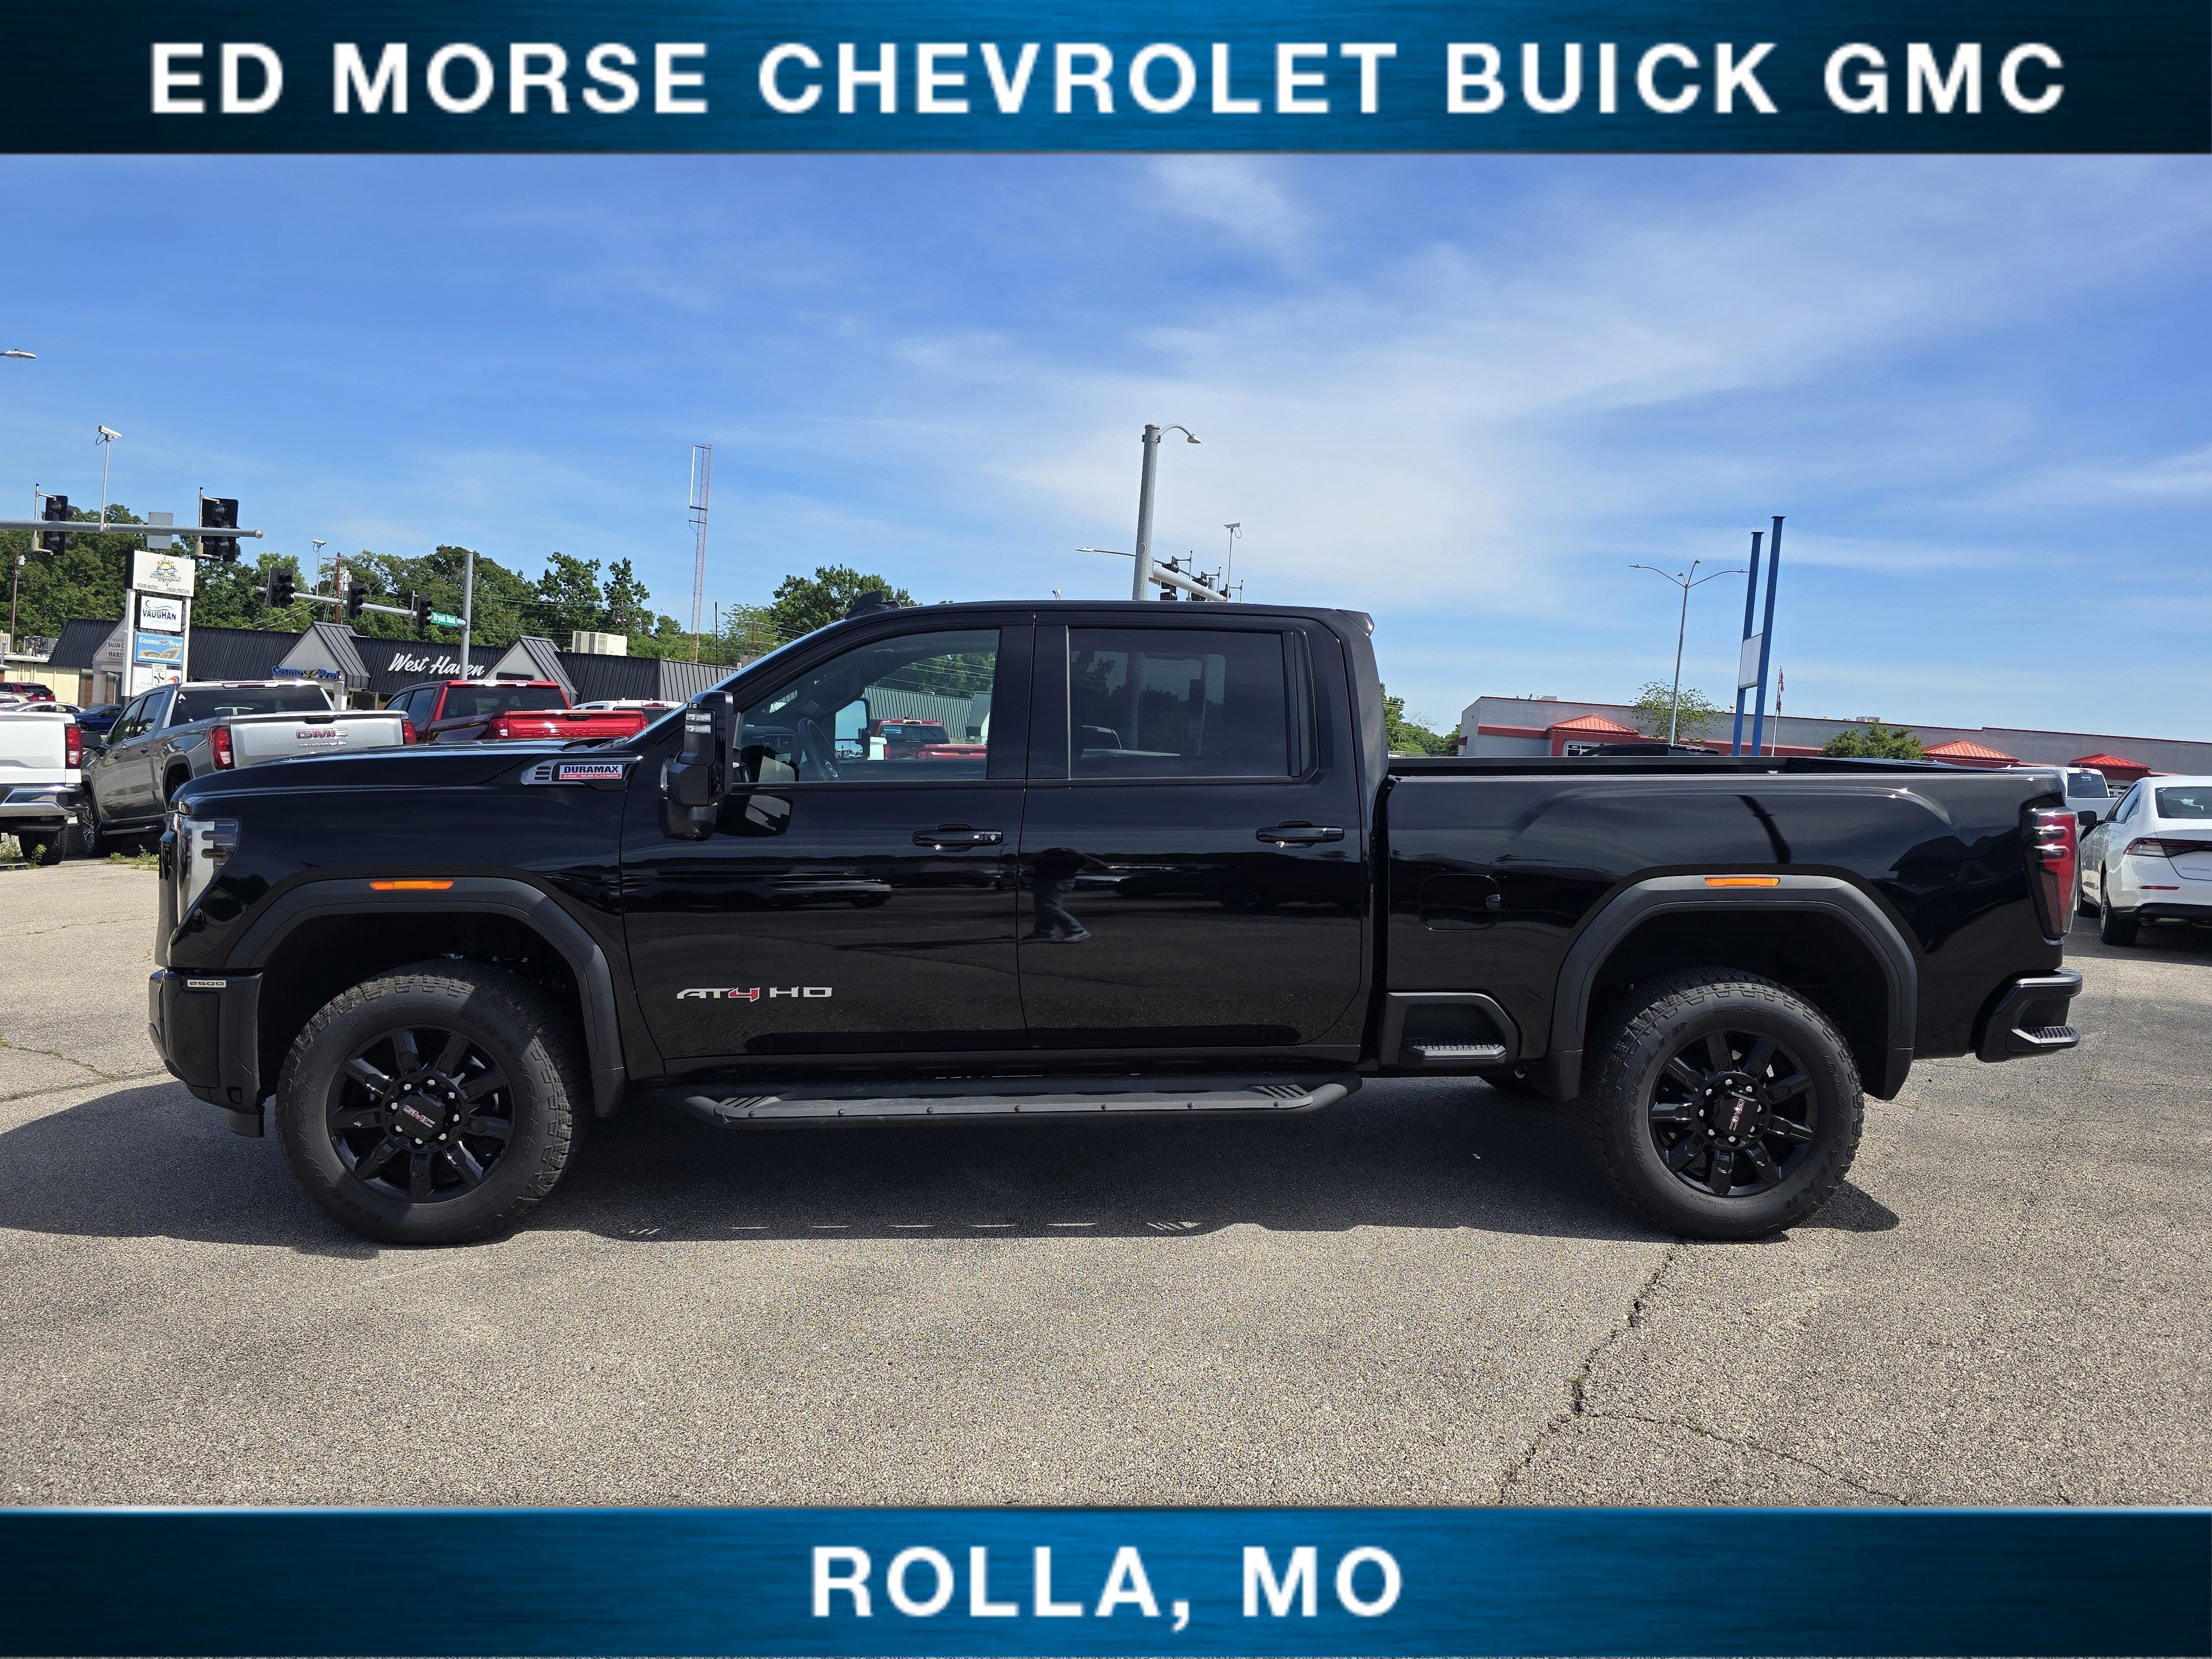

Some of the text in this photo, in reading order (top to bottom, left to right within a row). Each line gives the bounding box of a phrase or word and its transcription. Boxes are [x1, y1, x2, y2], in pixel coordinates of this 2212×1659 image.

[143, 608, 176, 620] VAUGHAN
[139, 637, 160, 645] Cosmo
[388, 653, 430, 672] West
[272, 665, 342, 680] Cosmo Prof
[296, 728, 348, 739] GMC
[677, 986, 833, 1003] AT4 HD
[1626, 1020, 1688, 1165] WRANGLER
[403, 1104, 436, 1128] GMC
[1729, 1098, 1745, 1131] GMC
[1783, 1055, 1847, 1211] GOODYEAR
[296, 1067, 383, 1223] GOODYEAR
